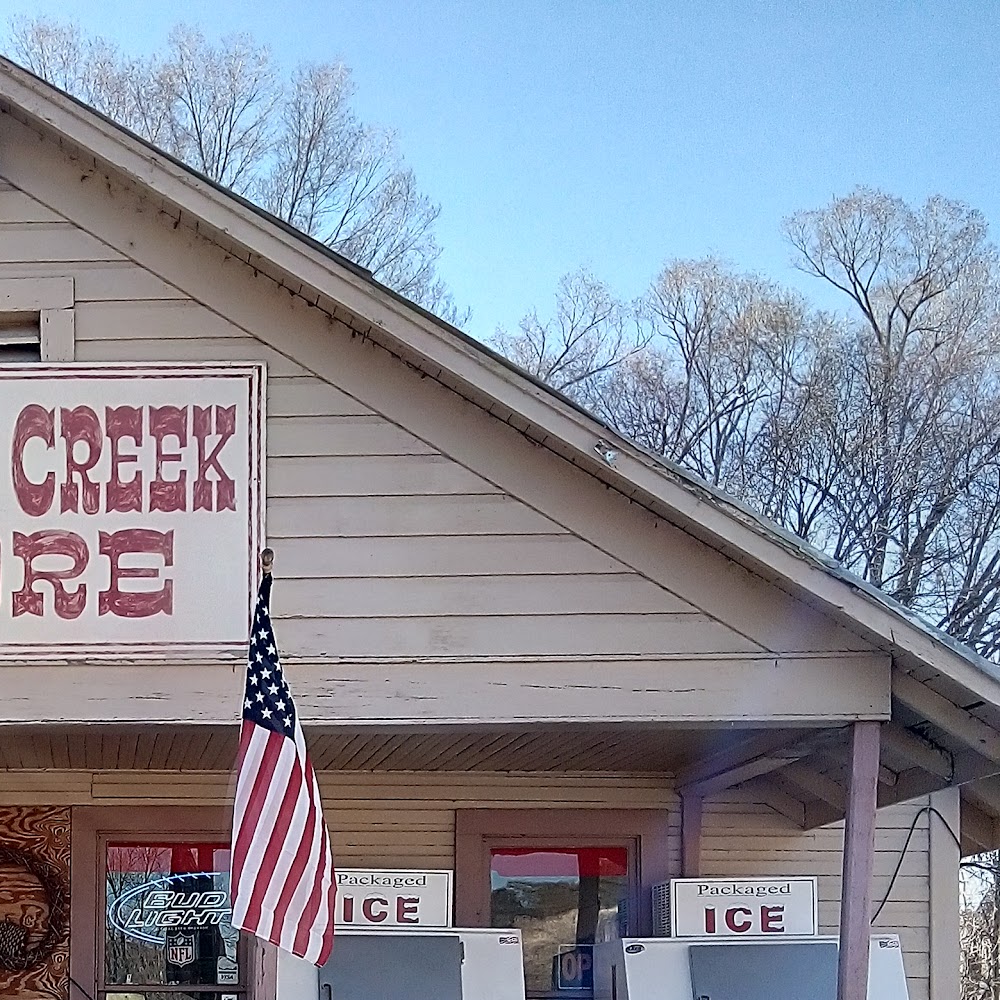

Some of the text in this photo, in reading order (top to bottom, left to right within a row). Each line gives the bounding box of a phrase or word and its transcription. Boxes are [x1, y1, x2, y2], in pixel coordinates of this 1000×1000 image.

[12, 403, 237, 517] CREEK
[337, 873, 427, 888] Packaged
[697, 883, 791, 897] Packaged
[143, 891, 227, 908] BUD
[343, 893, 420, 924] ICE
[125, 909, 232, 928] LIGHT
[704, 903, 785, 933] ICE
[170, 947, 192, 961] NFL
